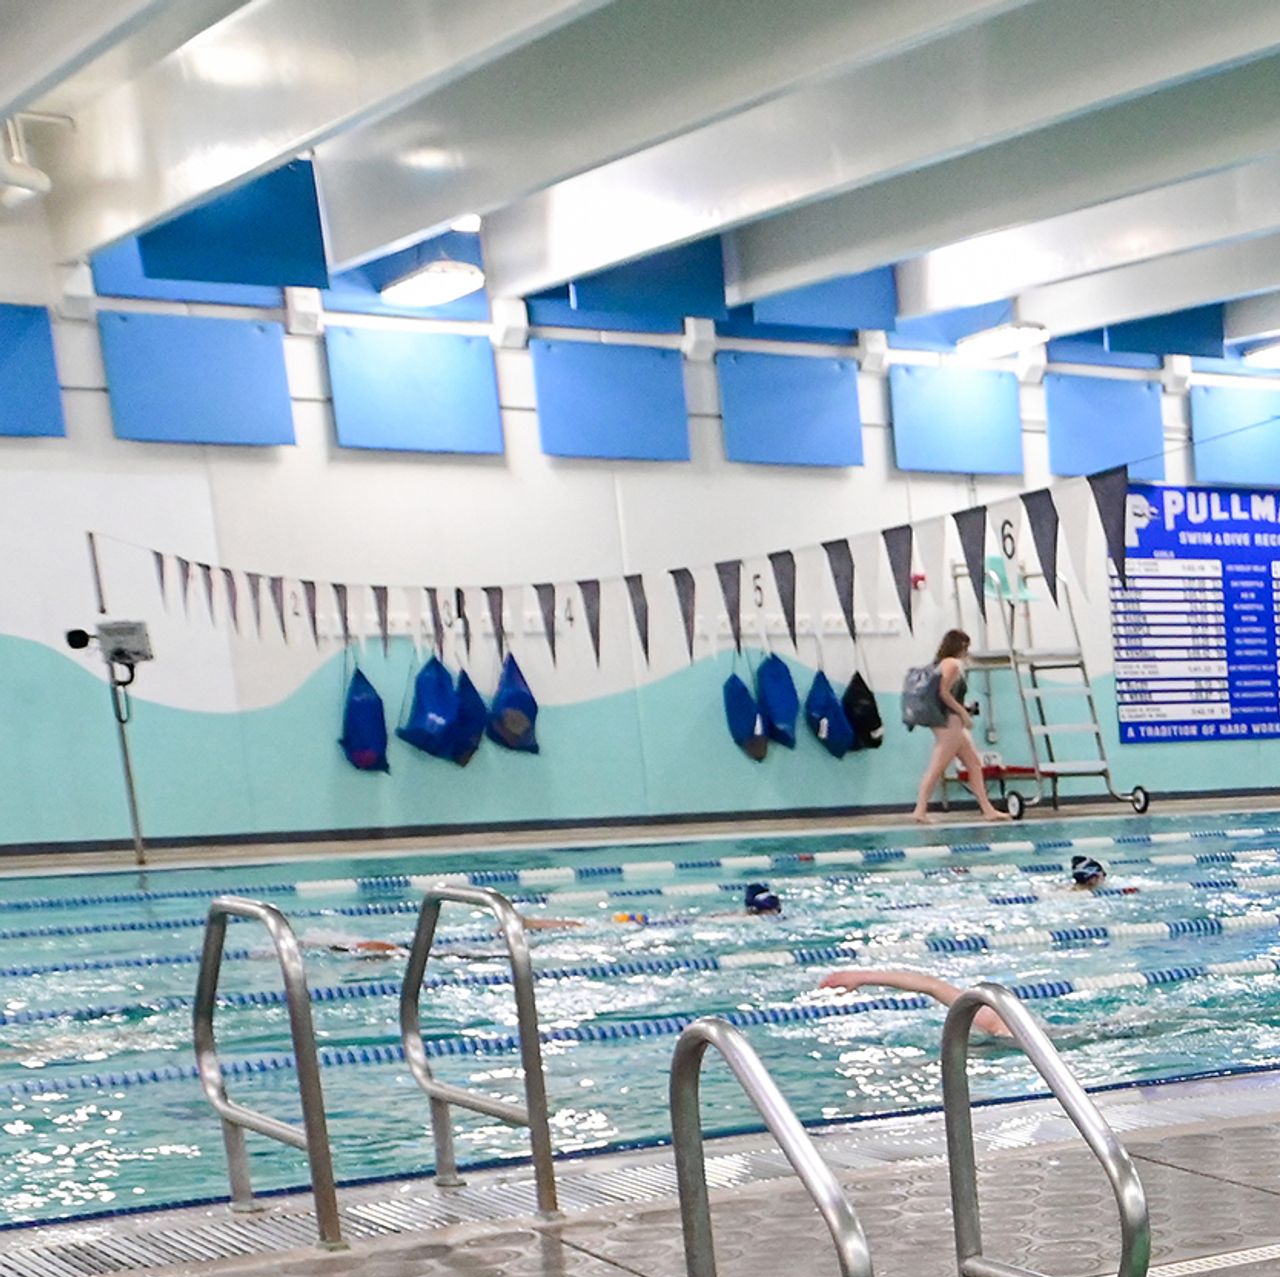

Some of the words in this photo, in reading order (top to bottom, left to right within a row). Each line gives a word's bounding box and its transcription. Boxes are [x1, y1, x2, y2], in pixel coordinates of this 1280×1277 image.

[1000, 519, 1016, 560] 6
[1178, 531, 1213, 545] SWIM
[1223, 533, 1250, 546] DIVE
[753, 574, 763, 608] 5
[564, 597, 574, 627] 4
[1127, 726, 1135, 737] A
[1139, 724, 1198, 737] TRADITION
[1201, 724, 1216, 736] OF
[1219, 723, 1248, 735] HARD
[1252, 722, 1280, 734] WORK
